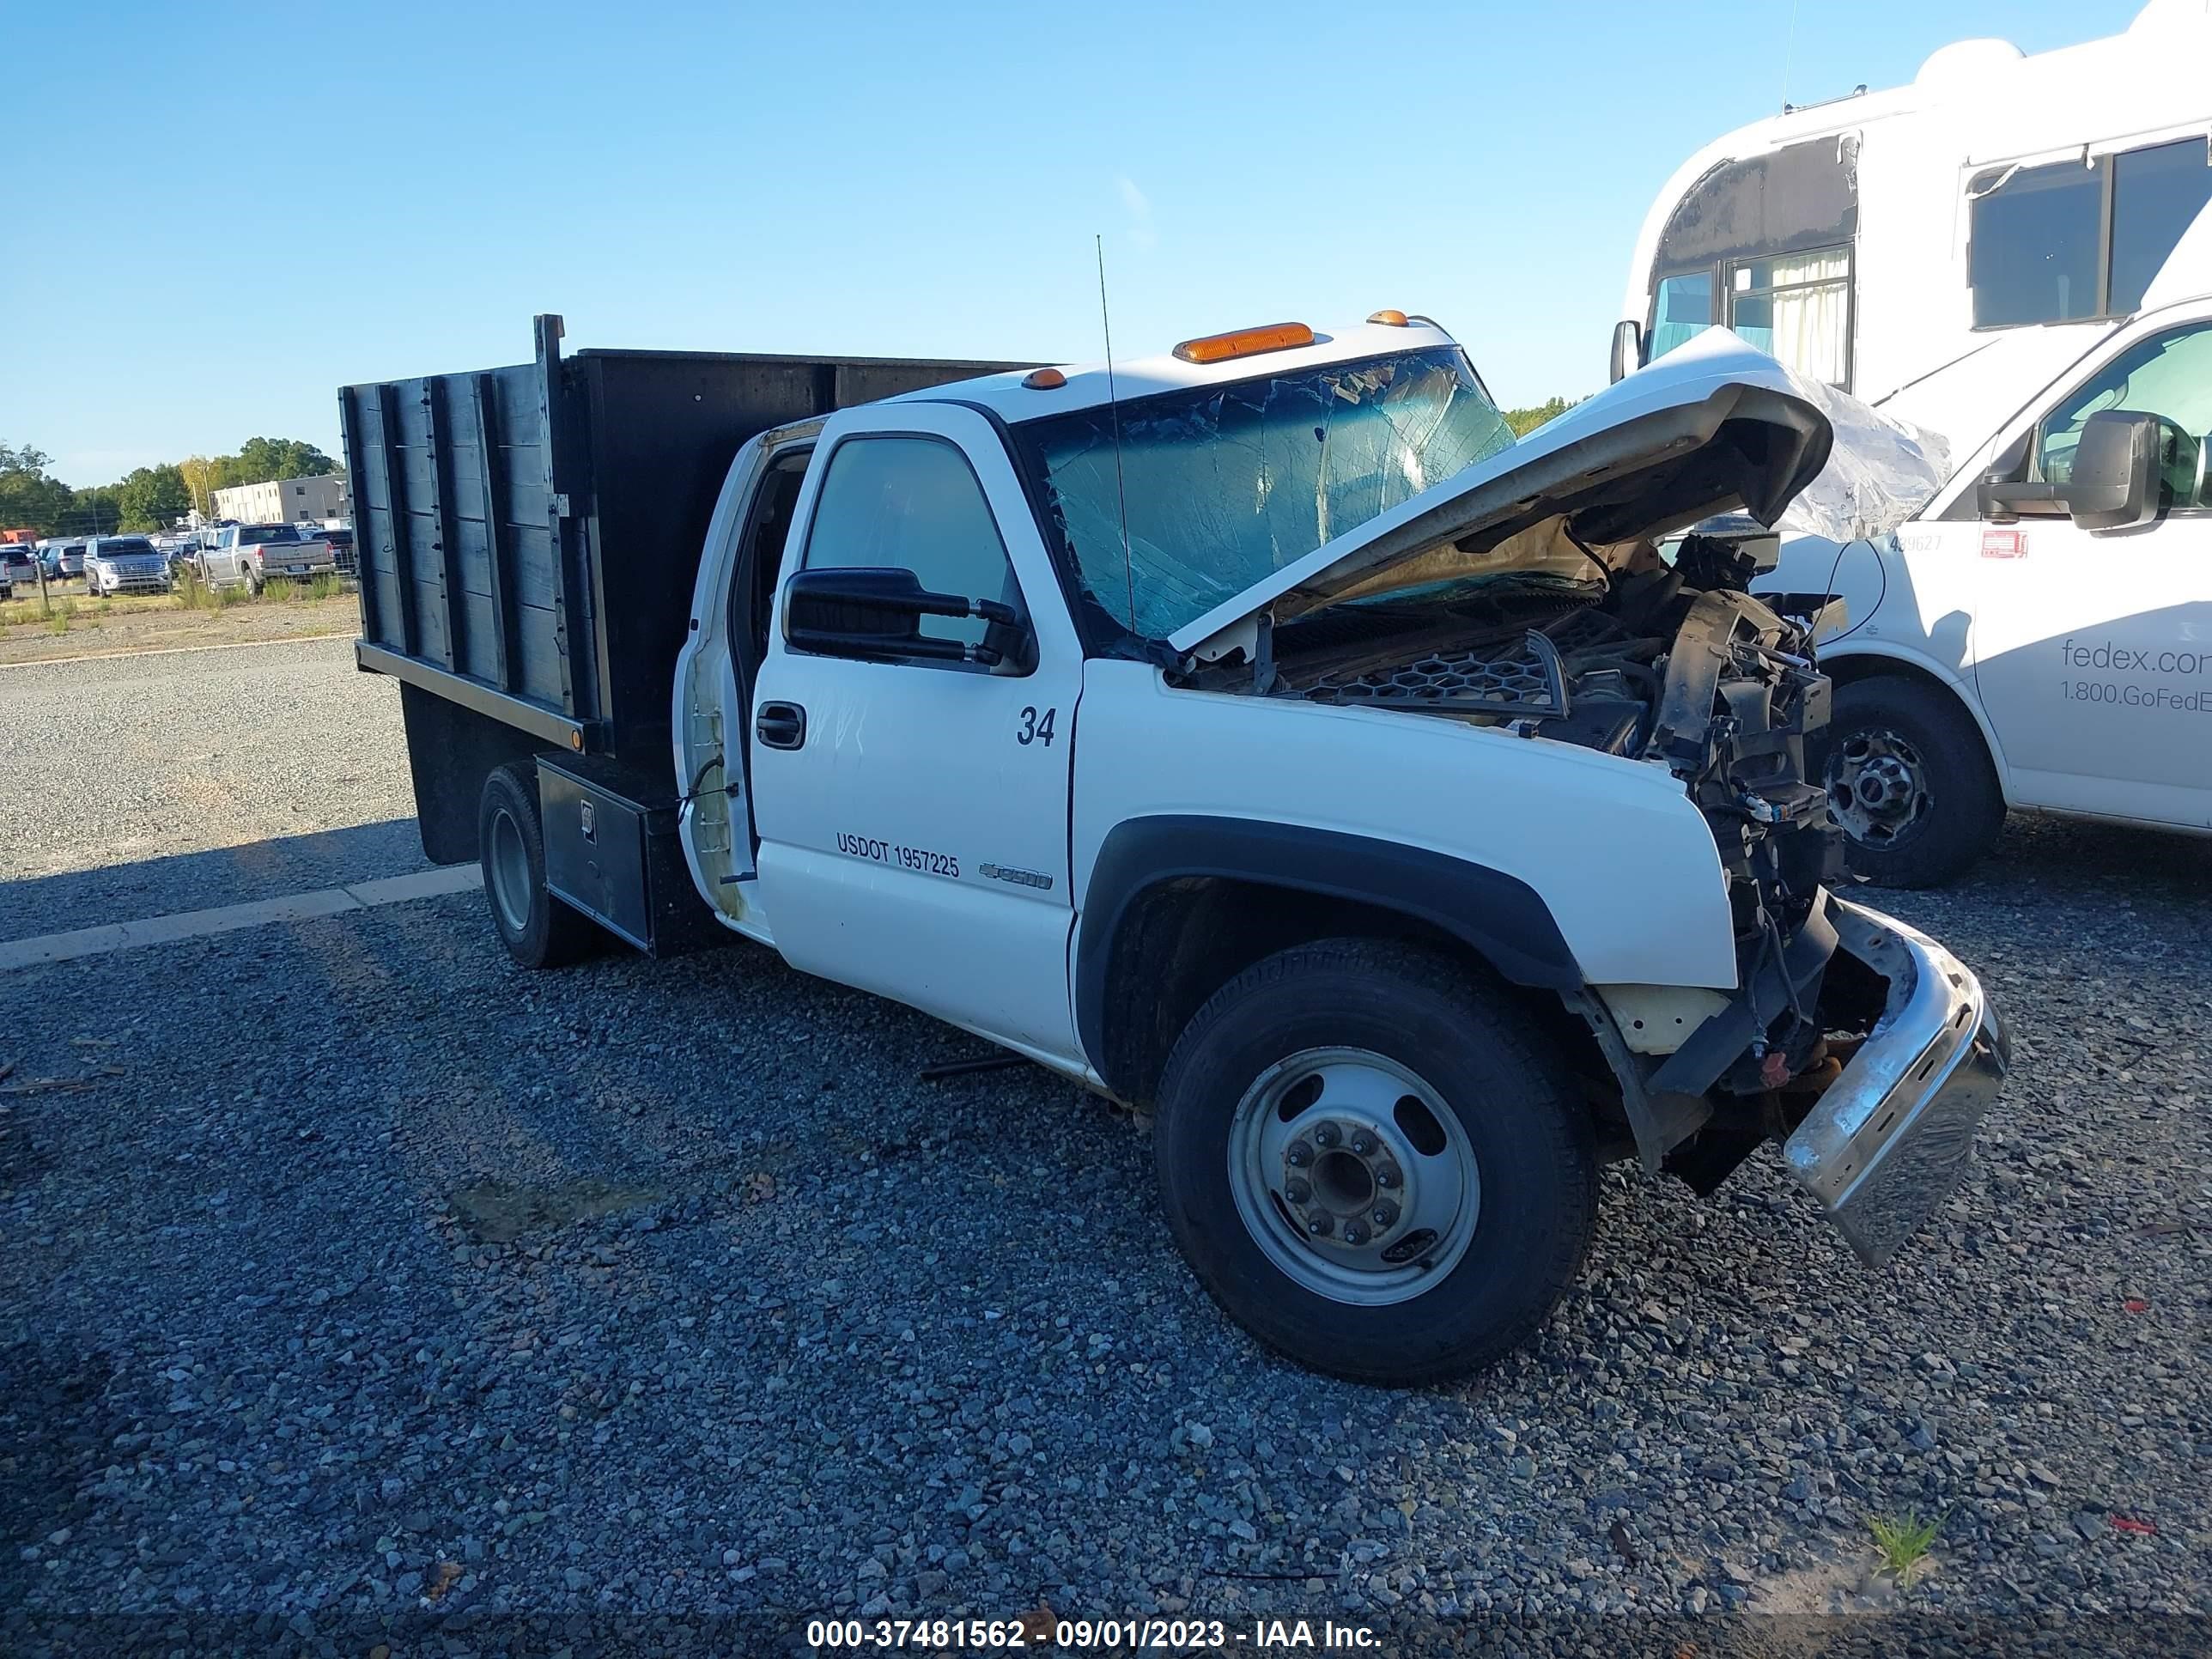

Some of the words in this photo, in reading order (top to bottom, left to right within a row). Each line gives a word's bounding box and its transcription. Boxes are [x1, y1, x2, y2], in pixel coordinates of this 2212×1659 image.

[1890, 534, 1942, 553] 439627
[1017, 706, 1057, 747] 34
[836, 831, 889, 863] USDOT
[894, 845, 960, 878] 1957225
